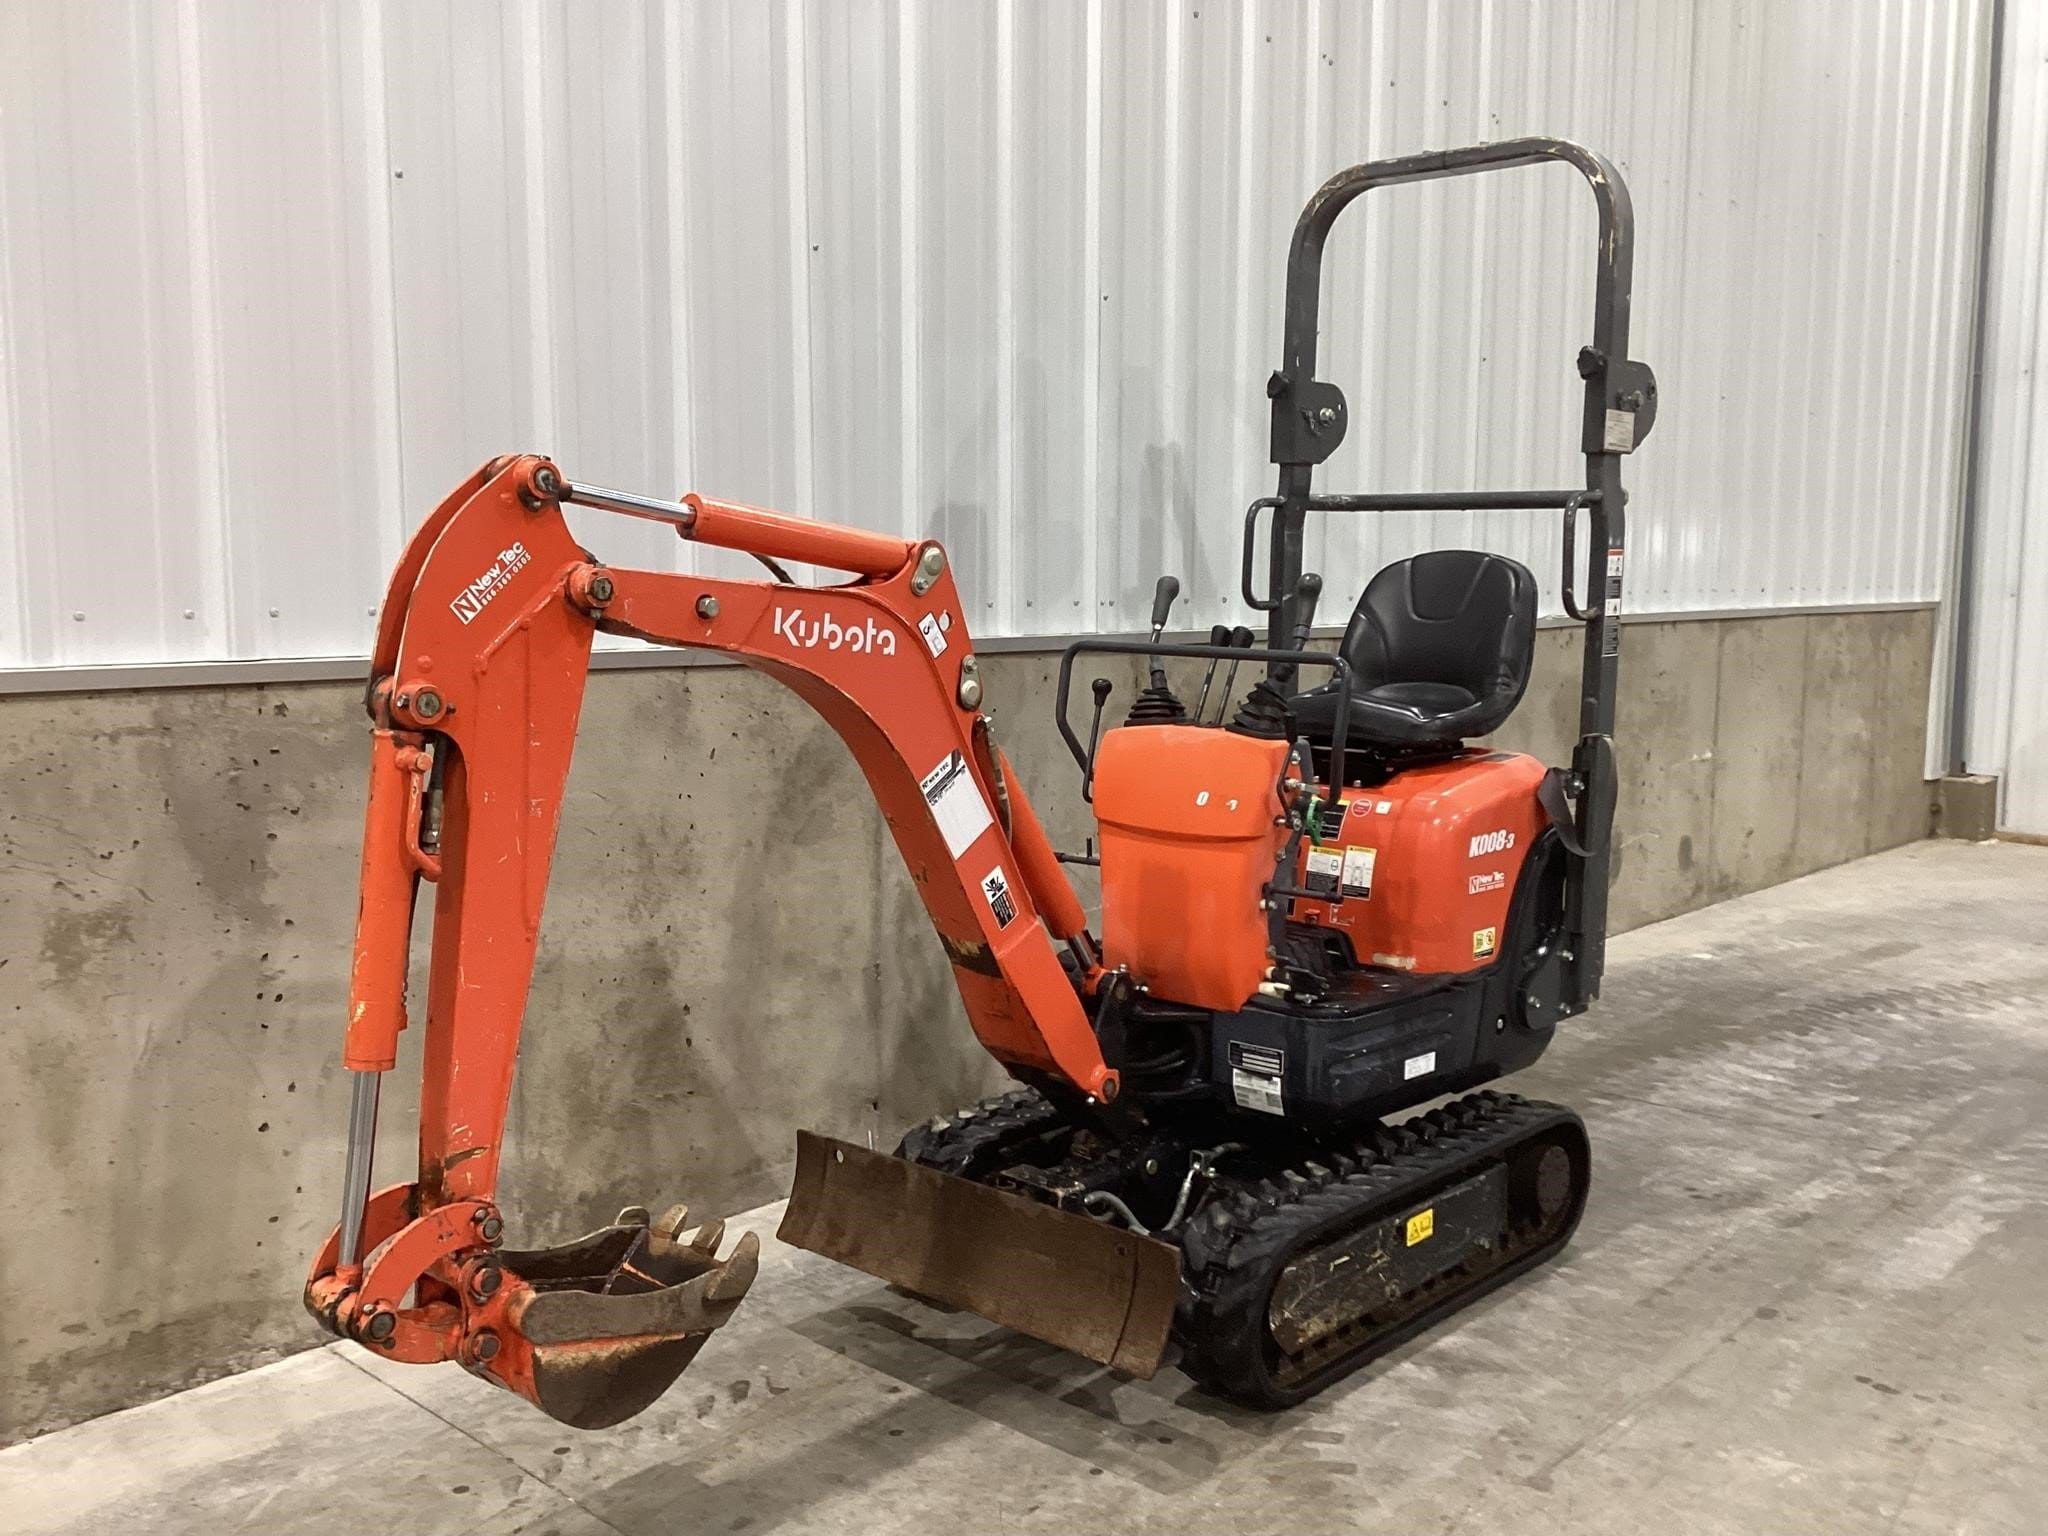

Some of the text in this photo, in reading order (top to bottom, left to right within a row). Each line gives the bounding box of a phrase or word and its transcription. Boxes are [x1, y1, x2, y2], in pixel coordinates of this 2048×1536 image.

[468, 562, 501, 597] New
[496, 541, 524, 566] Tec
[773, 606, 897, 656] Kubota
[1468, 829, 1515, 858] K008-3
